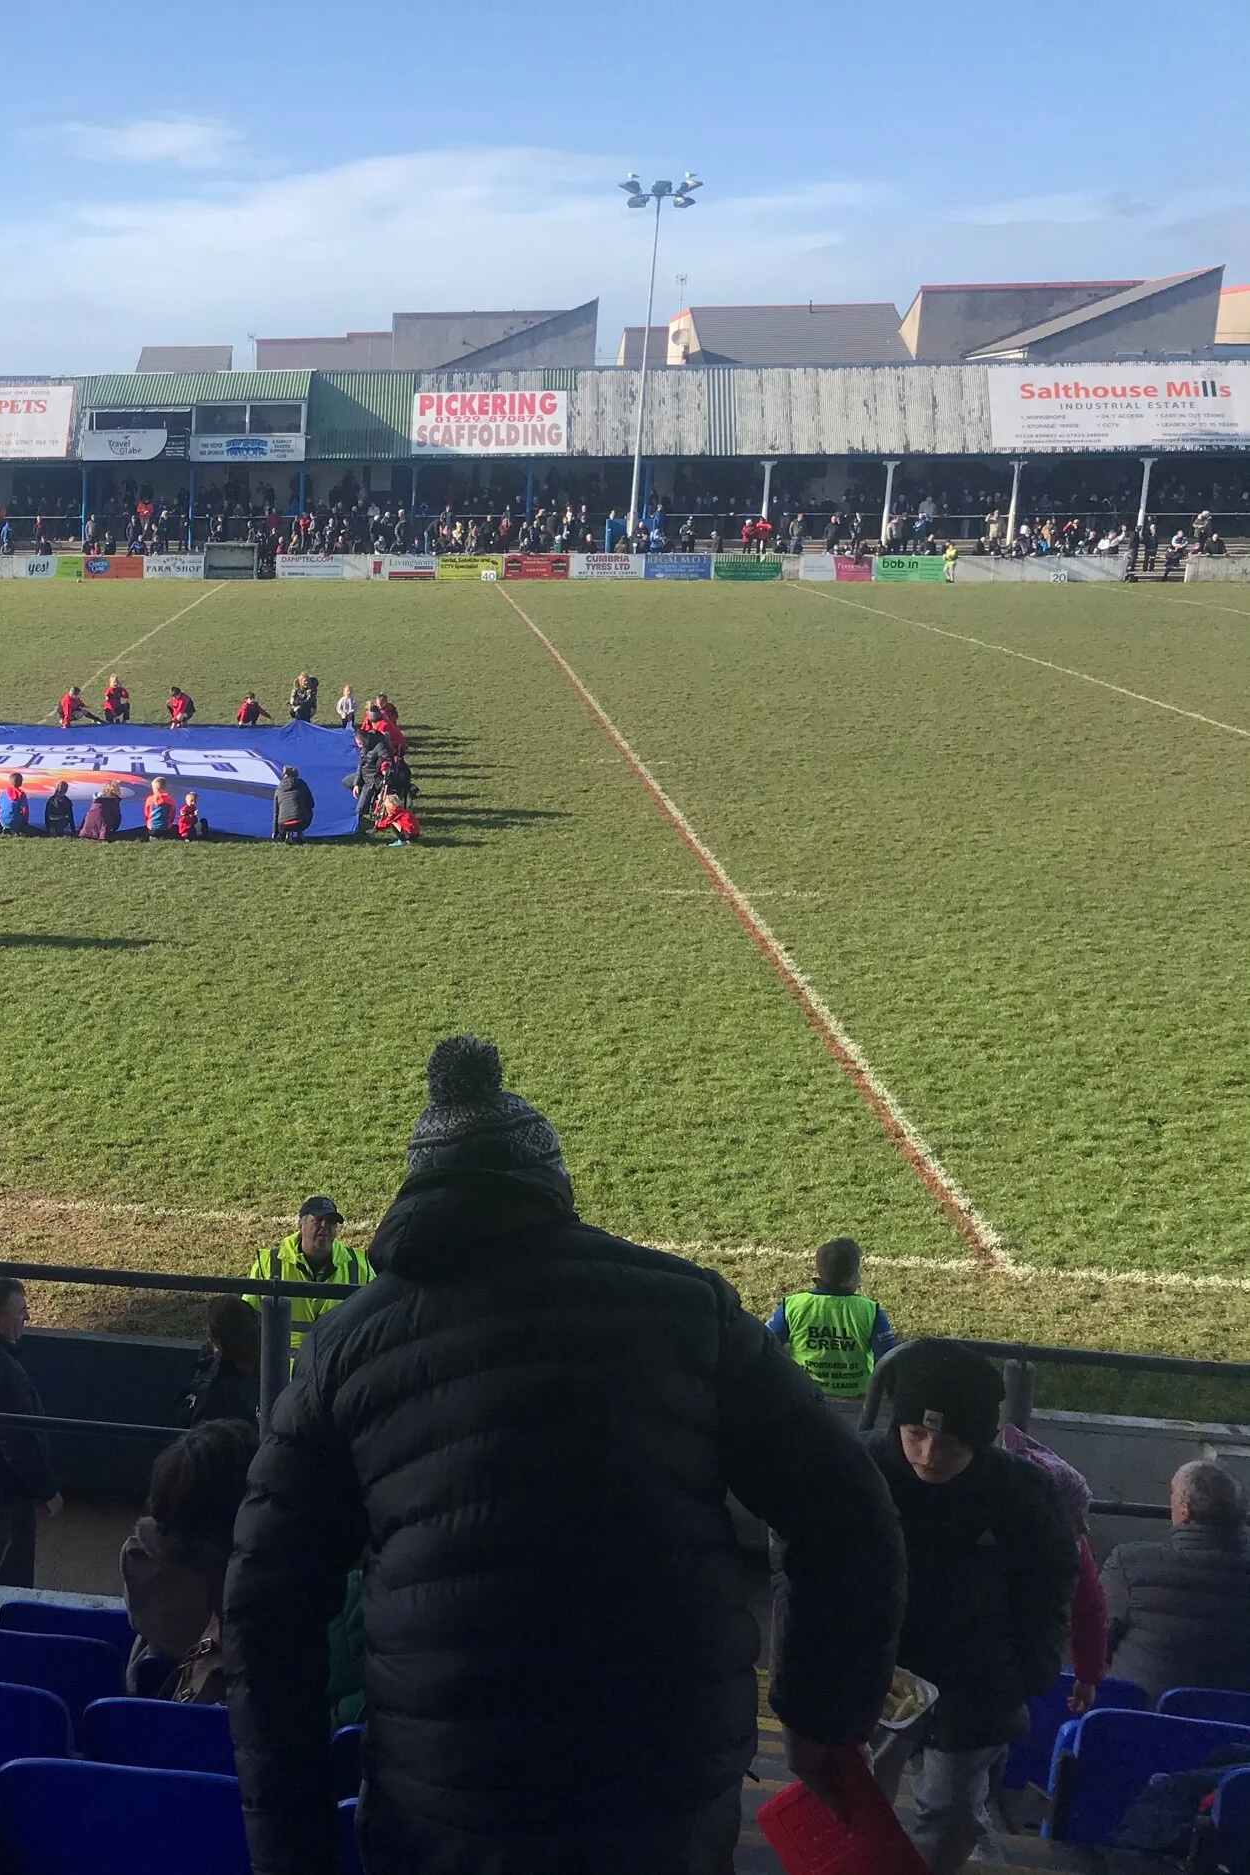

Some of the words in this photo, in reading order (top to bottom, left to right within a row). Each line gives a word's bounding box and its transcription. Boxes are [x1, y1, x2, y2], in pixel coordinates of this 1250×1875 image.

[1019, 381, 1158, 400] Salthouse
[1166, 380, 1232, 398] Mills
[419, 392, 558, 416] PICKERING
[1059, 402, 1141, 410] INDUSTRIAL
[1147, 401, 1196, 409] ESTATE
[435, 416, 481, 424] 01229
[488, 415, 545, 423] 870875
[416, 422, 563, 448] SCAFFOLDING
[108, 439, 131, 447] Travel
[586, 555, 630, 563] CUMBRIA
[882, 558, 904, 569] bob
[908, 558, 919, 569] in
[28, 561, 49, 576] yes!
[146, 565, 171, 573] FARM
[176, 565, 201, 573] SHOP
[585, 563, 612, 571] TYRES
[614, 563, 631, 571] LTD
[482, 572, 495, 581] 40
[1052, 573, 1067, 582] 20
[808, 1326, 852, 1340] BALL
[806, 1339, 856, 1352] CREW
[804, 1359, 848, 1369] SPONSORED
[832, 1382, 859, 1390] LEAGUE
